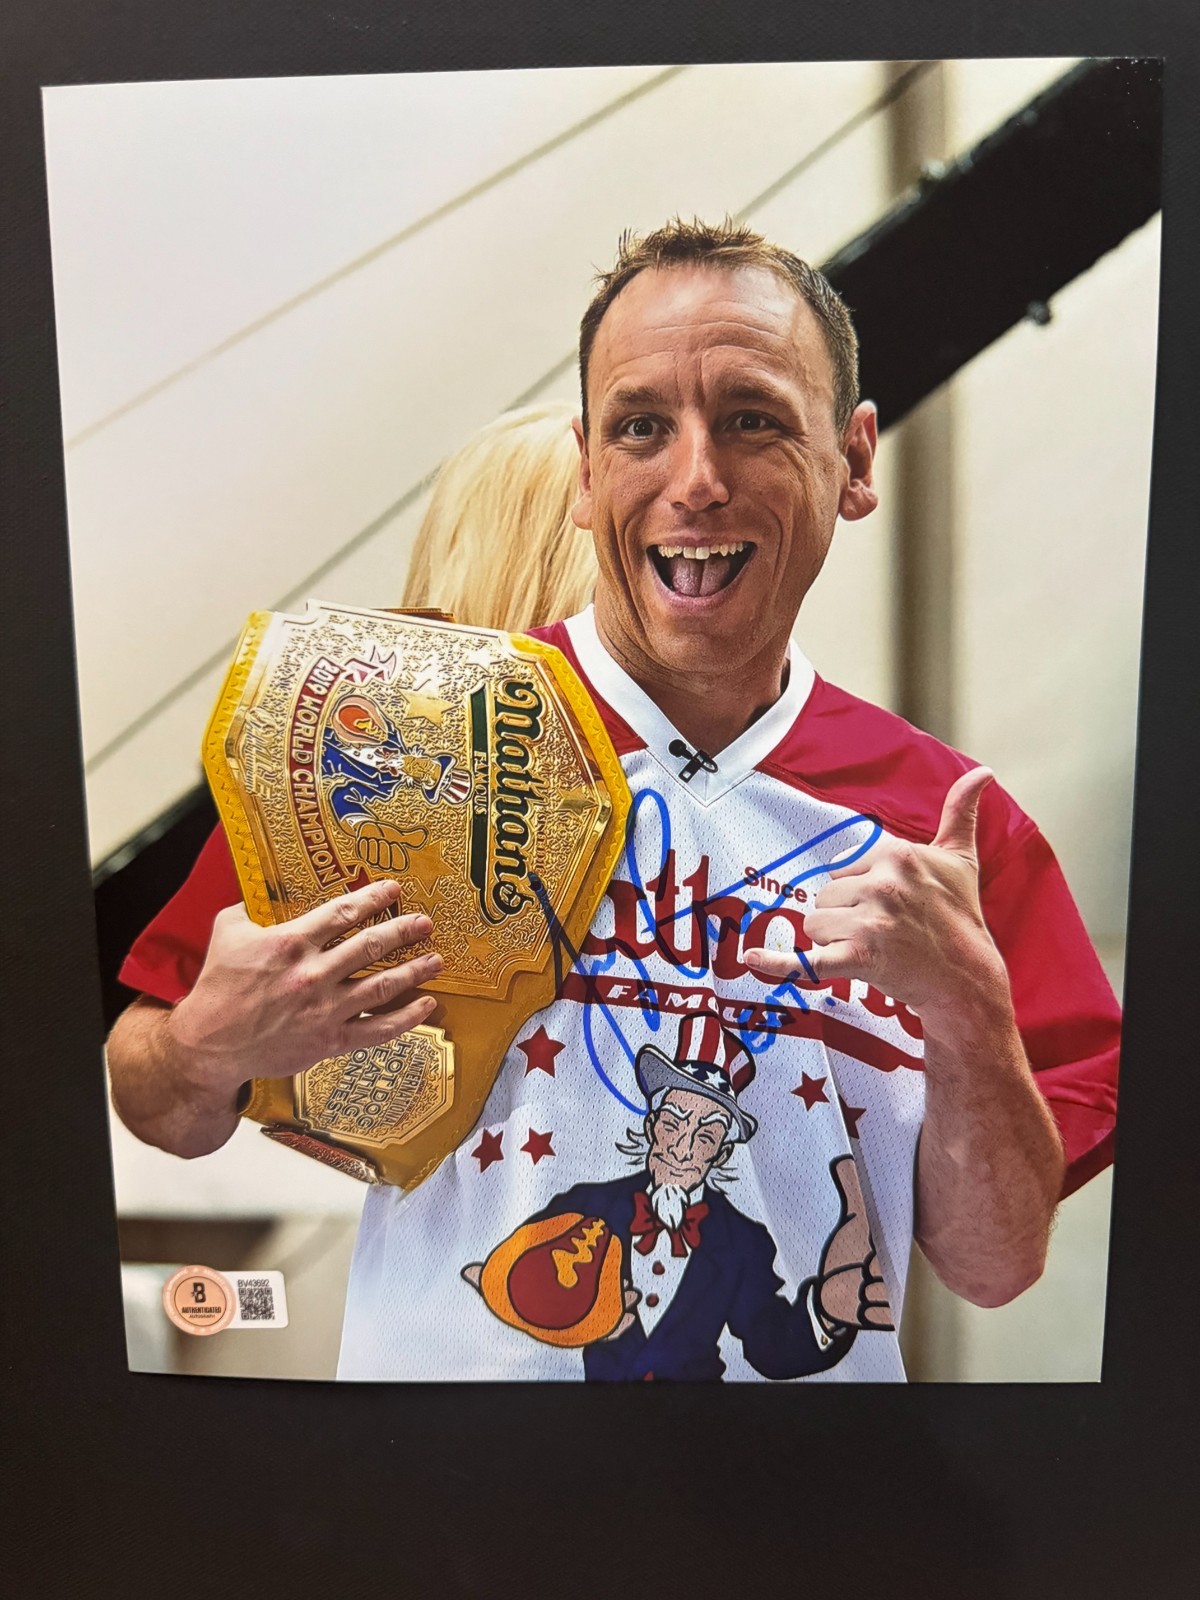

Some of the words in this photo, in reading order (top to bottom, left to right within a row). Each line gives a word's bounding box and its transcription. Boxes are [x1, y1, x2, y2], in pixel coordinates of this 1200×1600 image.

[316, 656, 343, 698] 2019
[292, 695, 322, 764] WORLD
[473, 750, 487, 816] FAMOUS
[292, 769, 343, 888] CHAMPION
[743, 865, 808, 904] Since
[319, 1048, 369, 1124] ONTEST
[341, 1046, 392, 1118] EATING
[380, 1053, 427, 1128] INTERNATIONAL
[384, 1040, 413, 1090] HOT
[357, 1088, 390, 1130] DOG
[181, 1306, 222, 1314] AUTHENTICATED
